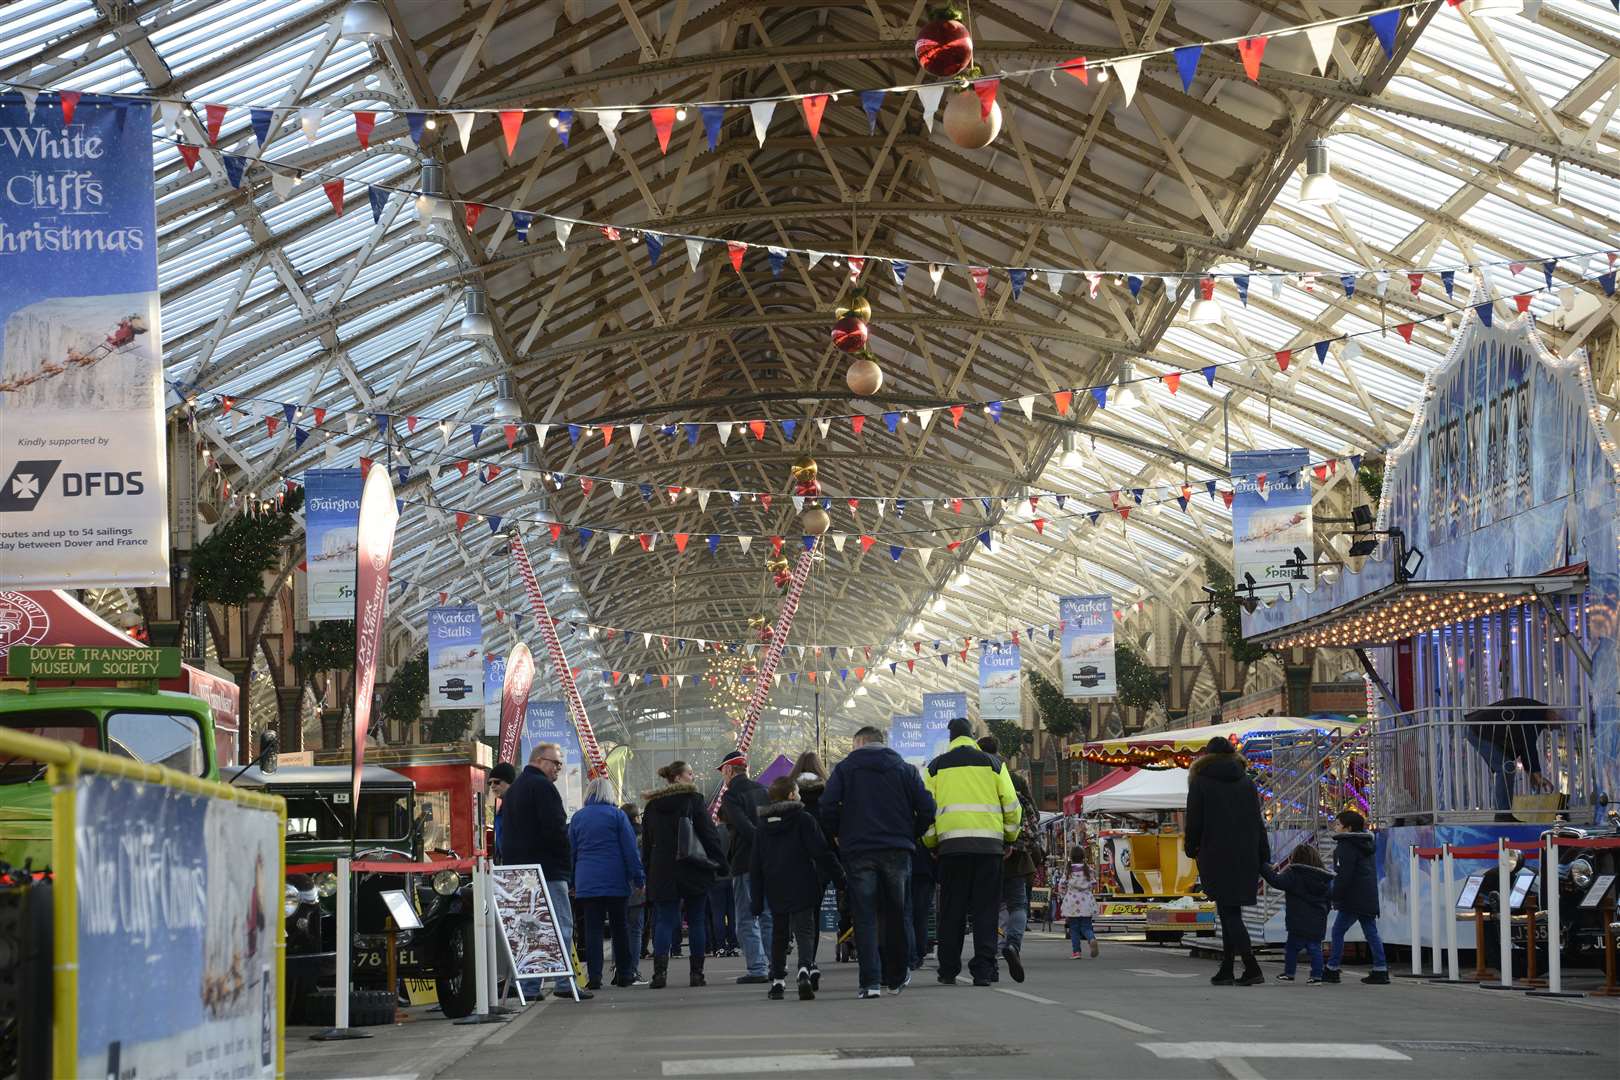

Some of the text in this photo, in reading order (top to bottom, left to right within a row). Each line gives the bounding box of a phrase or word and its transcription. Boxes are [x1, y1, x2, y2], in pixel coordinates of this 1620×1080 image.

[0, 127, 103, 159] White
[7, 171, 103, 210] Cliffs
[0, 222, 144, 252] hristmas
[18, 436, 109, 448] Kindly supported by
[62, 471, 144, 497] DFDS
[31, 529, 50, 538] and
[53, 530, 66, 539] up
[69, 528, 80, 537] to
[82, 528, 94, 536] 54
[96, 527, 133, 537] sailings
[18, 540, 62, 549] between
[64, 539, 92, 548] Dover
[96, 538, 114, 547] and
[117, 538, 148, 546] France
[0, 591, 42, 614] NSPORT
[1064, 600, 1107, 613] Market
[432, 611, 476, 625] Market
[438, 625, 472, 639] Stalls
[30, 648, 162, 661] DOVER TRANSPORT
[984, 656, 1014, 667] Court
[31, 662, 160, 675] MUSEUM SOCIETY
[931, 699, 956, 708] White
[530, 708, 555, 718] White
[901, 721, 922, 730] White
[353, 952, 382, 967] 78
